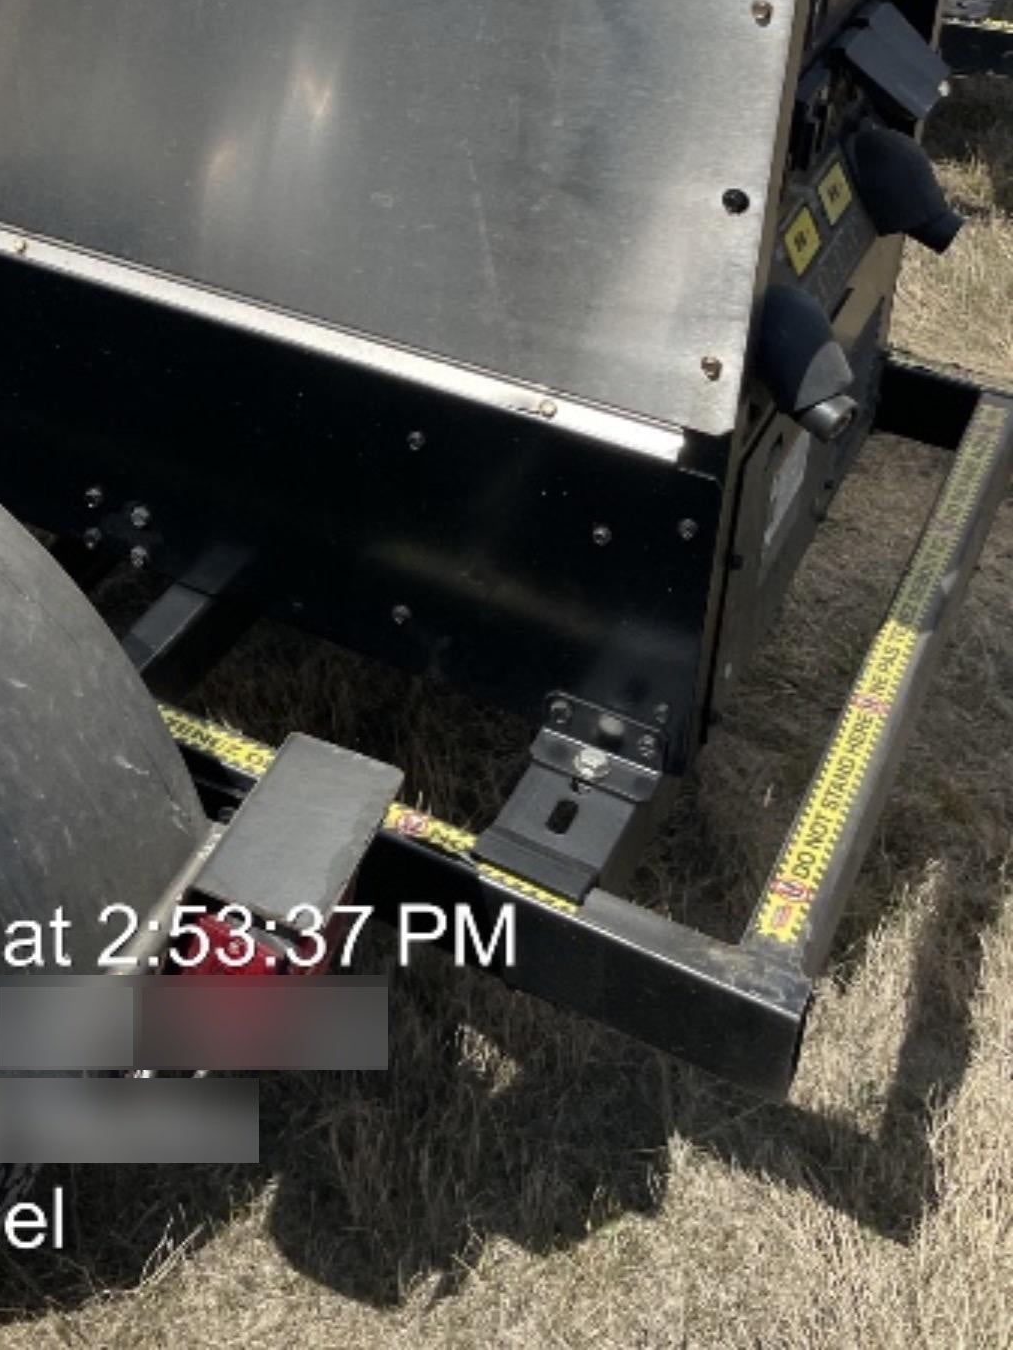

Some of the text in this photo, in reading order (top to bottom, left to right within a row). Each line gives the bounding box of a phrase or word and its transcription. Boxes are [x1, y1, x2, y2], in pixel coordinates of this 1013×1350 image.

[791, 712, 875, 880] DO NOT STAND HERE
